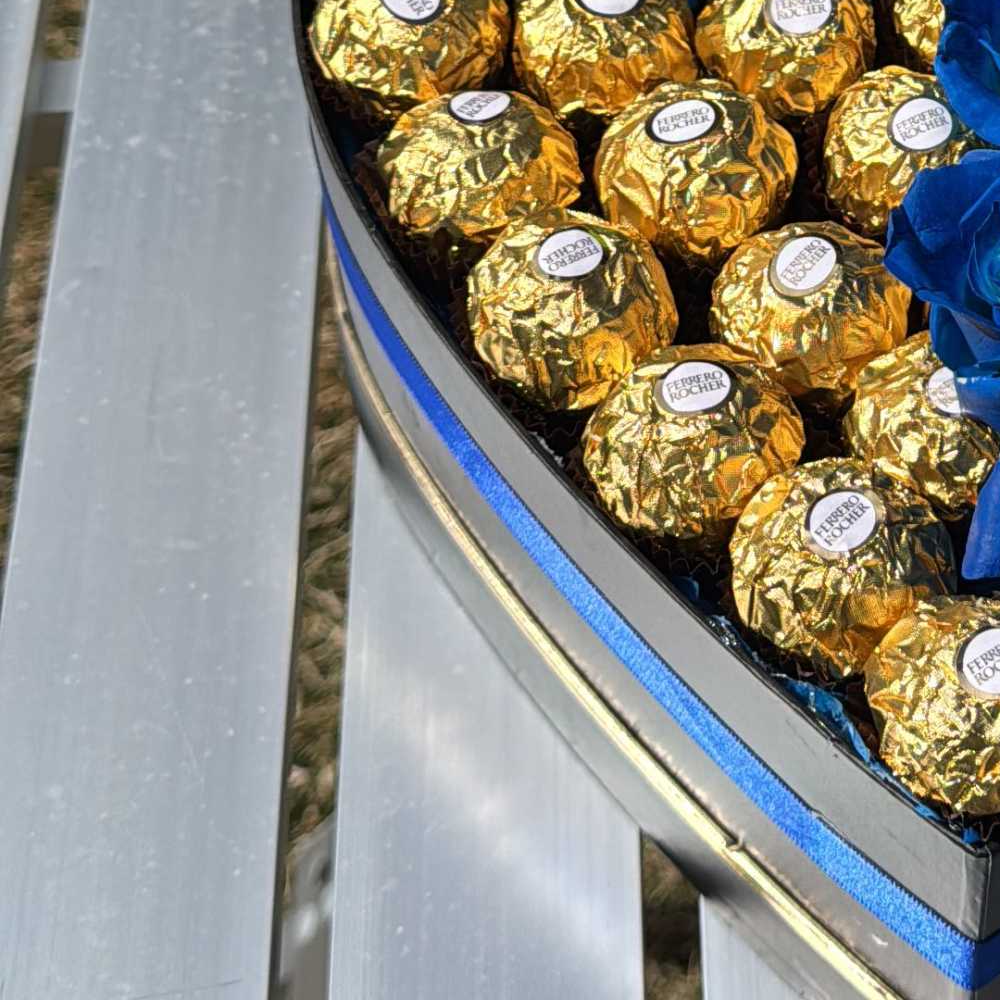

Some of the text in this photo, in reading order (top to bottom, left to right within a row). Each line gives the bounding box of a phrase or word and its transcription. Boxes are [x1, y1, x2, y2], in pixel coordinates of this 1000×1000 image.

[776, 3, 828, 21] ROCHER
[656, 106, 710, 127] FERRERO
[658, 115, 711, 134] ROCHER
[896, 106, 945, 132] FERRERO
[900, 115, 950, 141] ROCHER
[541, 237, 594, 264] ROCHER
[548, 245, 600, 271] FERRERO
[781, 239, 822, 280] FERRERO
[787, 245, 831, 286] ROCHER
[666, 370, 723, 393] FERRERO
[668, 380, 727, 403] ROCHER
[814, 494, 860, 538] FERRERO
